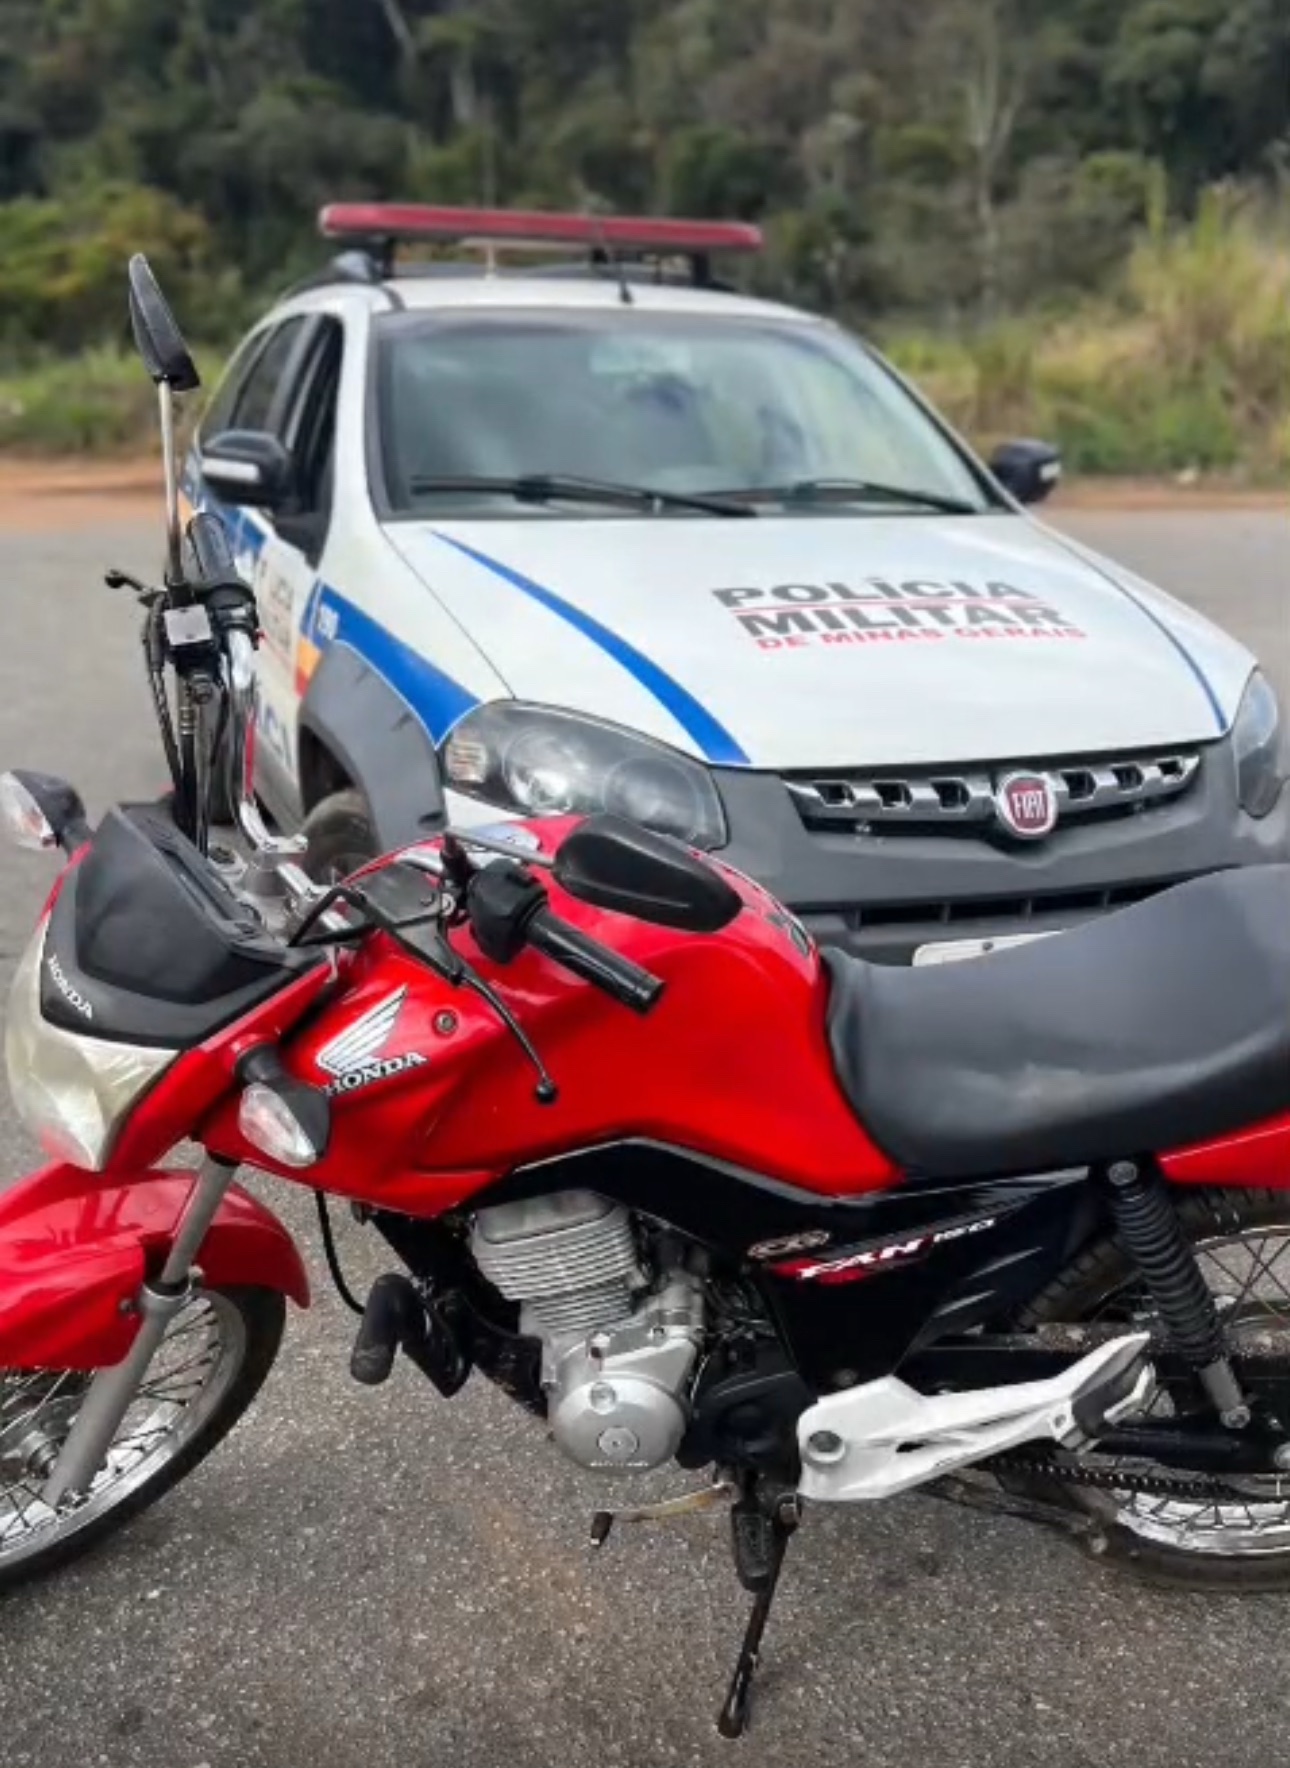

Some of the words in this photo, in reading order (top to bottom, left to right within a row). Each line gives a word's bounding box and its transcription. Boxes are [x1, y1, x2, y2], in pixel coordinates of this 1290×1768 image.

[736, 604, 1073, 637] MILITAR
[756, 634, 809, 651] DE
[821, 629, 944, 645] MINAS
[954, 626, 1087, 640] GERAIS
[1012, 790, 1045, 819] FIAT
[48, 953, 92, 1019] HONDA
[323, 1051, 427, 1096] HONDA
